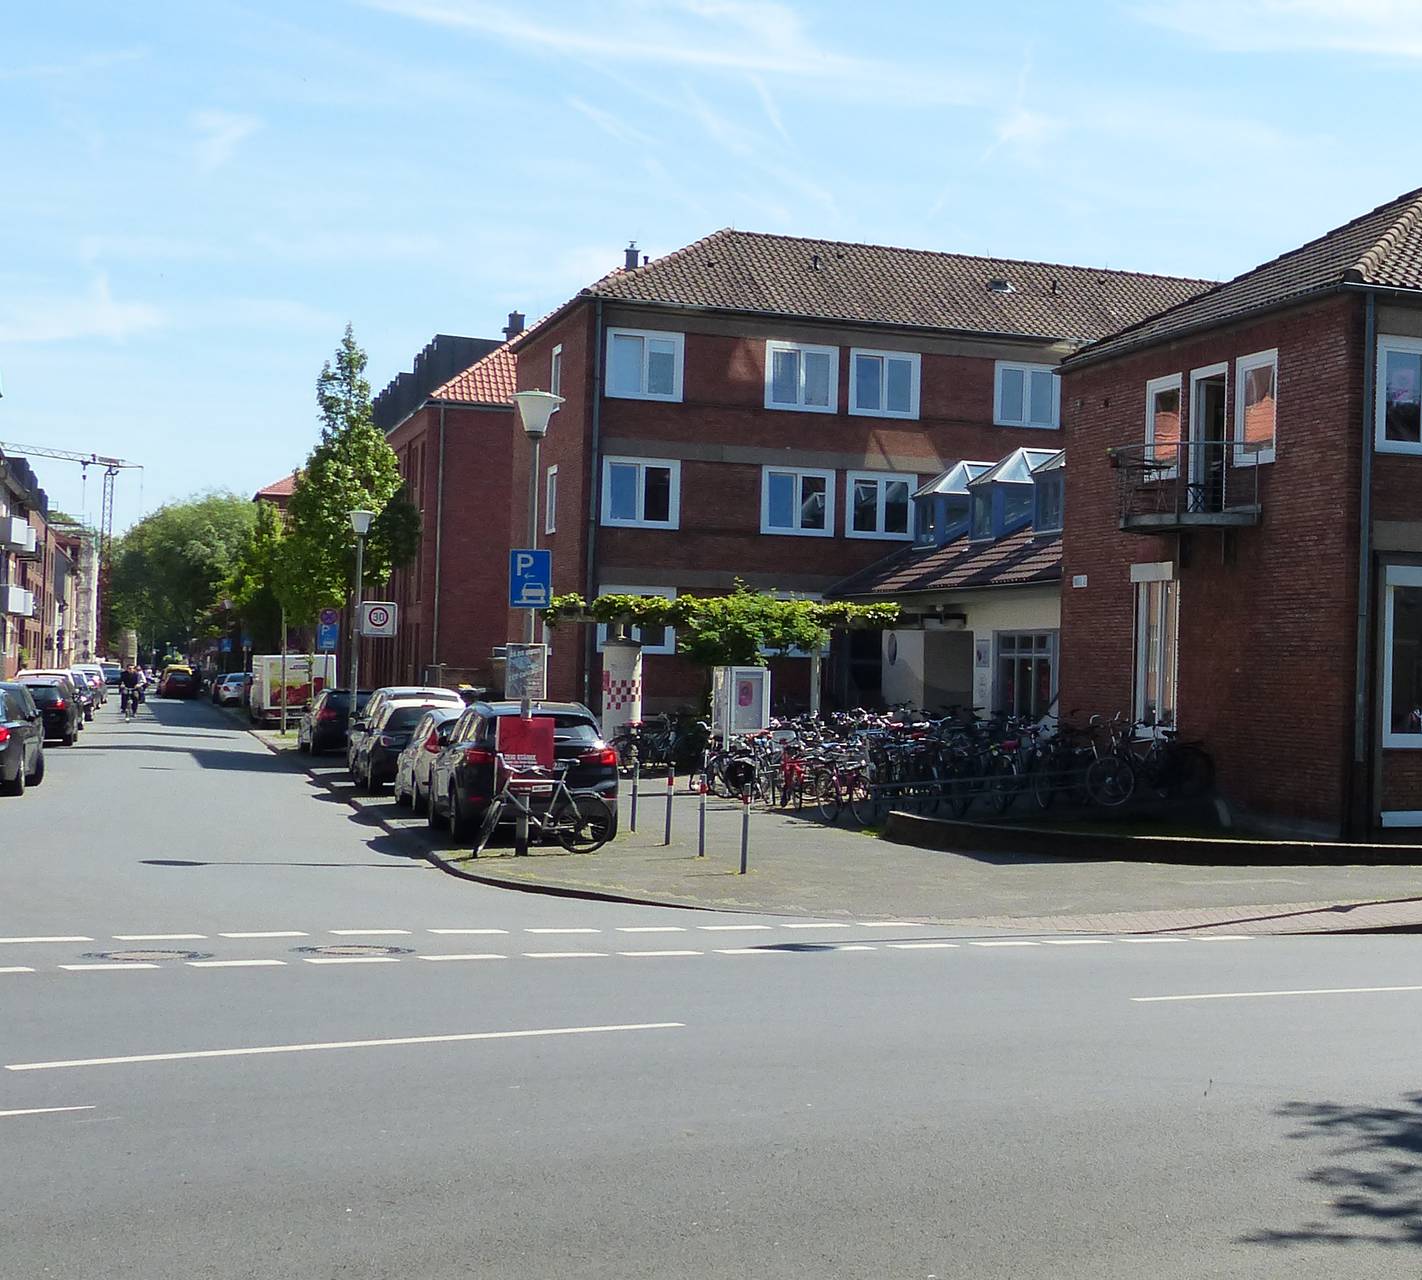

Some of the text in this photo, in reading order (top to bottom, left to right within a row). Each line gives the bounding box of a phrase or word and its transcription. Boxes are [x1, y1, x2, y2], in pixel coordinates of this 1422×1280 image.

[516, 553, 534, 577] P
[372, 612, 385, 622] 30
[321, 624, 330, 636] P
